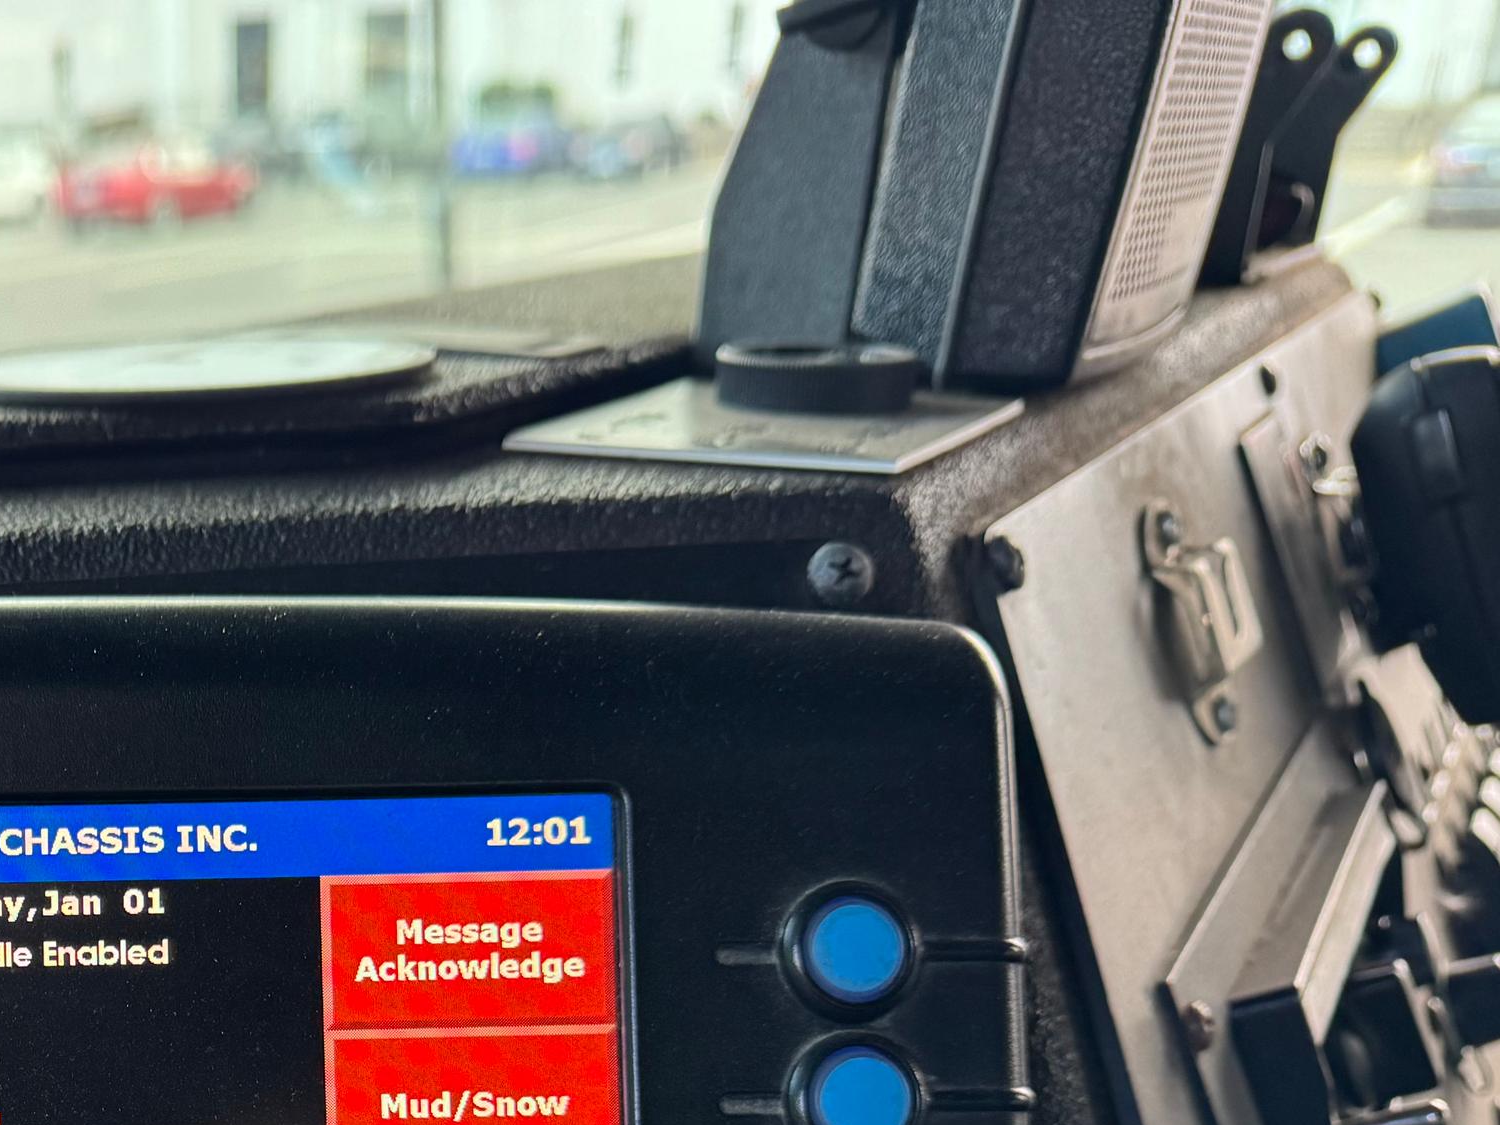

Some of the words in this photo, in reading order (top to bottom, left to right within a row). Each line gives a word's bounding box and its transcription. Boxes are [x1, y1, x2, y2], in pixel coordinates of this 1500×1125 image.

[176, 824, 258, 853] INC.
[486, 815, 592, 846] 12:01
[123, 887, 165, 915] 01
[396, 918, 543, 949] Message
[43, 938, 169, 967] Enabled
[354, 950, 586, 984] Acknowledge
[380, 1090, 570, 1122] Mud/Snow
